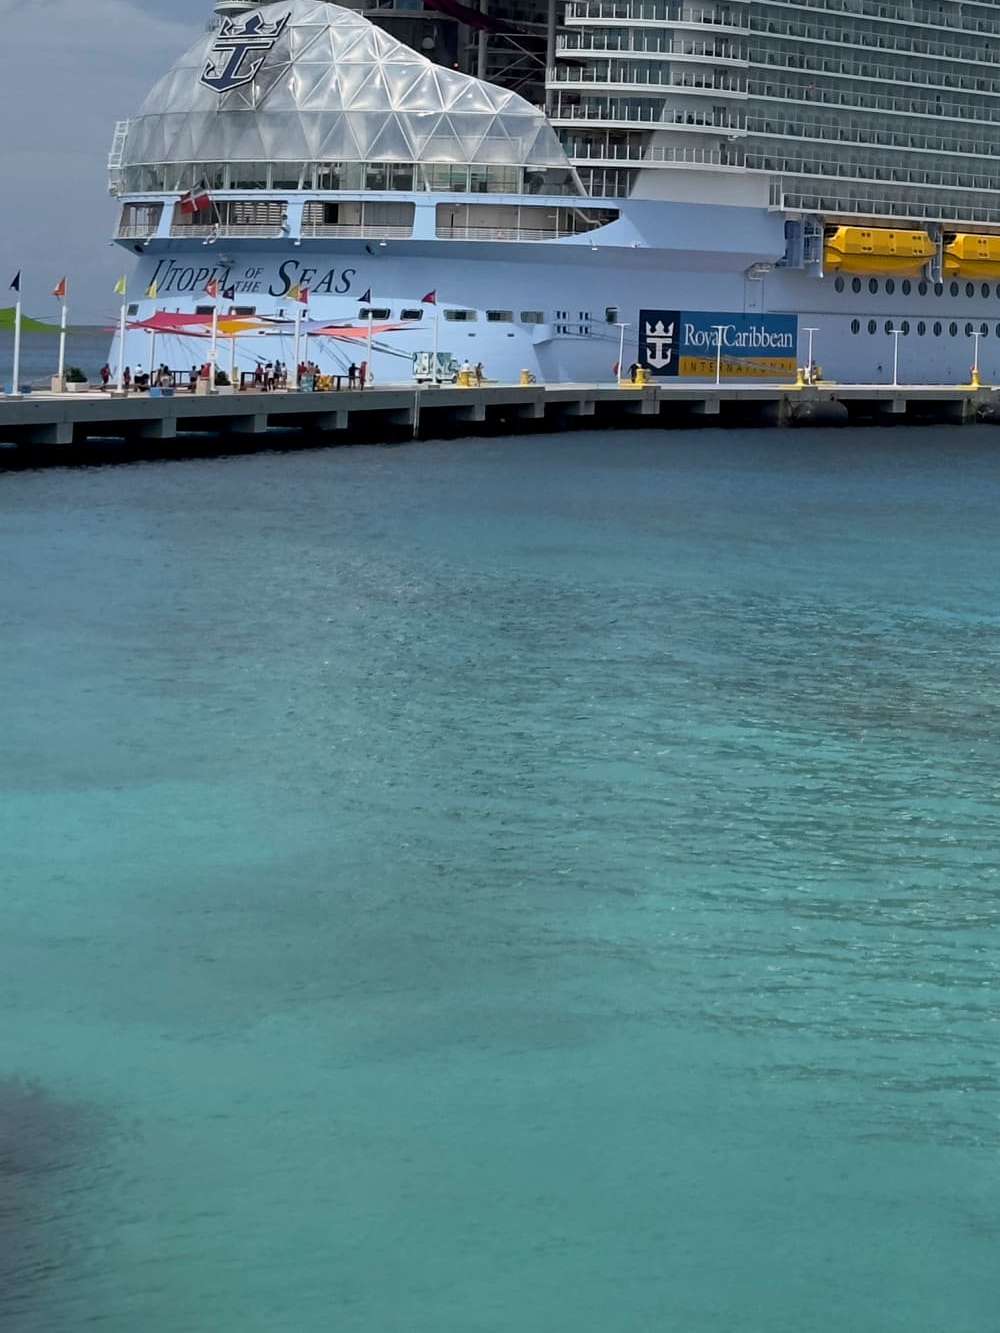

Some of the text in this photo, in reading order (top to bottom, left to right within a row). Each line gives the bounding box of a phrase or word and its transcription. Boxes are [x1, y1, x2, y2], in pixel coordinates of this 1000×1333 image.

[149, 259, 356, 297] UTOPIA OF THE SEAS
[724, 324, 793, 348] Caribbean
